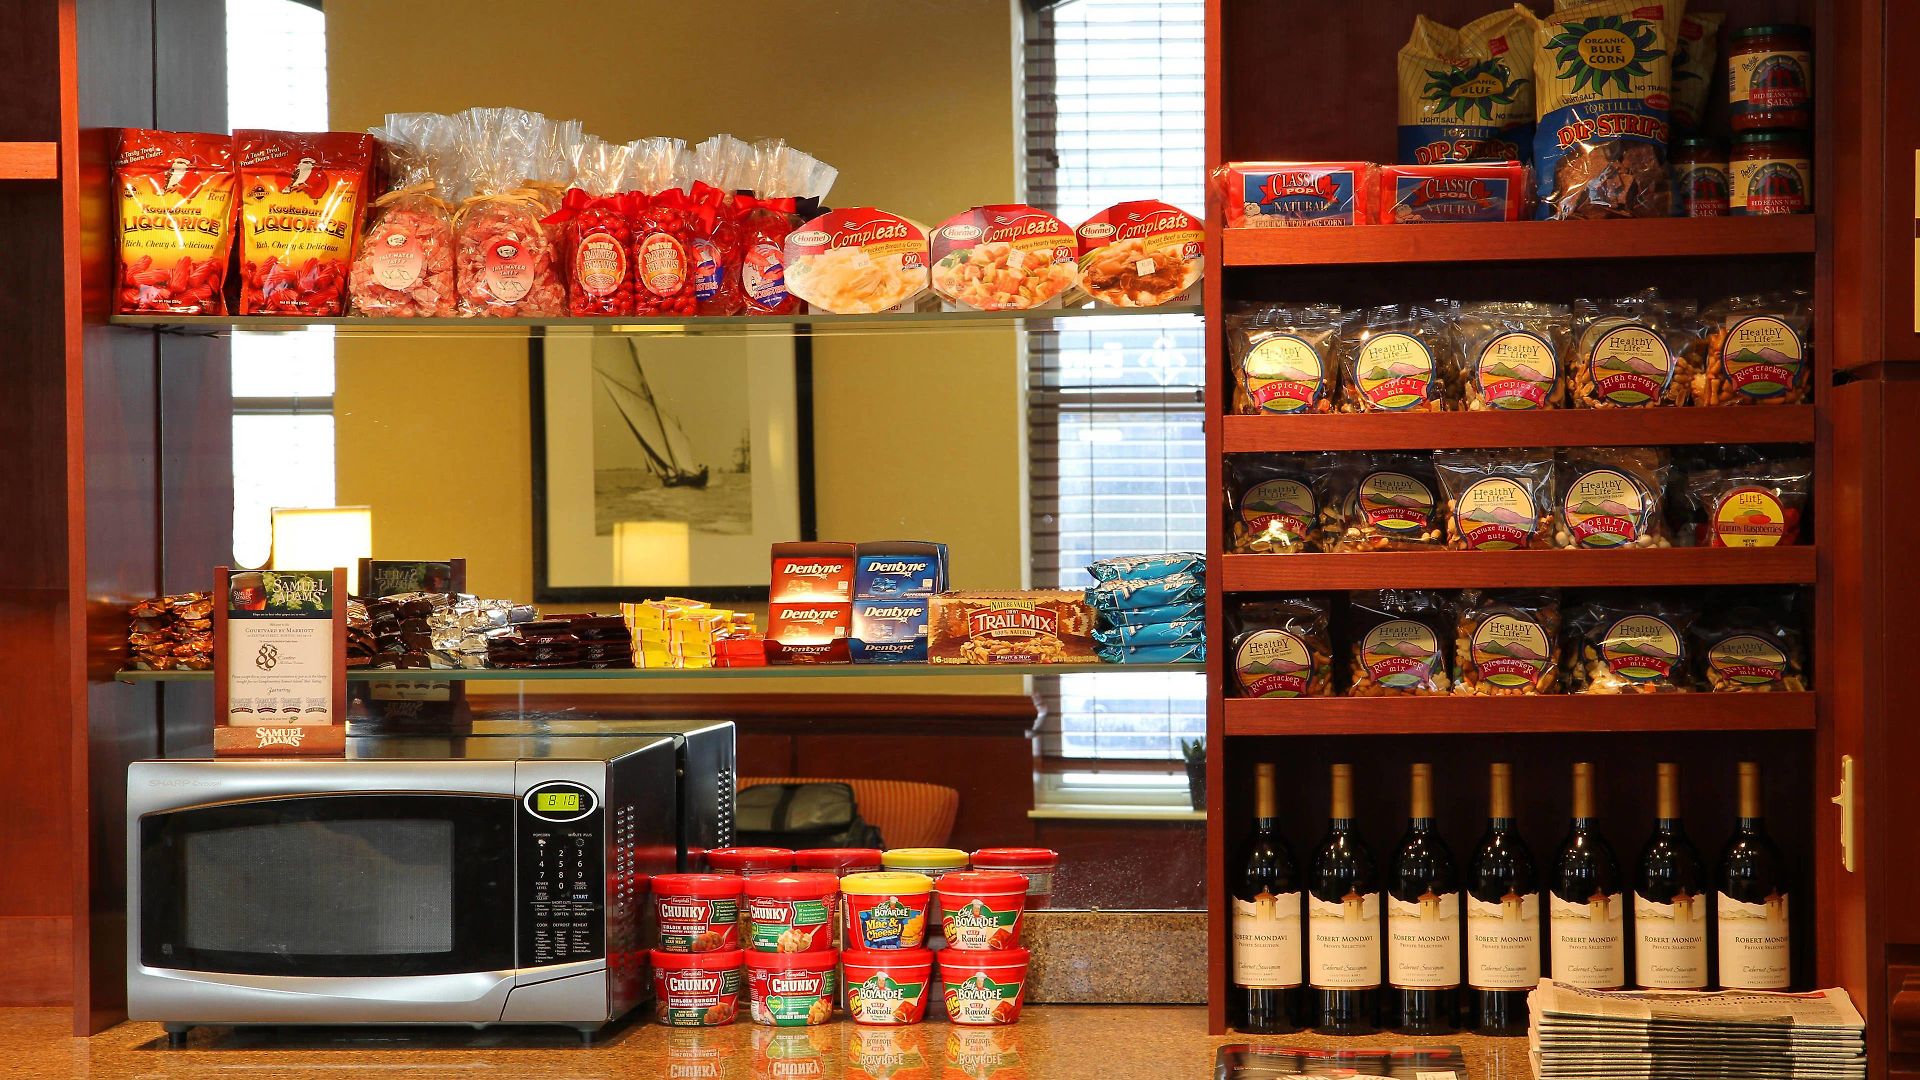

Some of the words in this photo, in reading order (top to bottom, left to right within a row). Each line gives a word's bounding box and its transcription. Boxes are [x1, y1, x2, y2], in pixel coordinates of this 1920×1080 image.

[1591, 46, 1621, 54] BLUE
[1589, 55, 1625, 64] CORN
[1562, 97, 1577, 105] LIGHT
[1585, 101, 1642, 113] TORTILLA
[1557, 120, 1595, 150] DIP
[1597, 113, 1668, 144] STRIPS
[1415, 141, 1450, 165] DIP
[1272, 172, 1324, 196] CLASSIC
[1426, 178, 1478, 200] CLASSIC
[207, 193, 225, 202] Red
[1274, 201, 1328, 212] NATURAL
[1427, 204, 1479, 215] NATURAL
[1763, 206, 1791, 216] SALSA
[123, 215, 221, 236] LIQUORICE
[1116, 213, 1188, 242] Compleats
[1292, 219, 1322, 227] POPPING
[948, 229, 977, 237] Hormel
[981, 217, 1059, 245] Compleats
[1084, 226, 1112, 234] Hormel
[798, 234, 826, 242] Hormel
[831, 223, 908, 251] Compleats
[1163, 234, 1176, 242] Beef
[1056, 249, 1068, 258] 90
[1185, 244, 1197, 254] 90
[644, 250, 678, 260] BAKED
[905, 254, 917, 264] 90
[645, 259, 679, 271] BEANS
[1735, 368, 1753, 382] Rice
[1602, 375, 1624, 389] High
[1594, 488, 1612, 496] Life
[1469, 526, 1496, 540] Deluxe
[1590, 525, 1618, 533] raisins
[1744, 524, 1783, 534] Raspberries
[784, 563, 842, 577] Dentyne
[868, 561, 926, 575] Dentyne
[273, 578, 328, 593] SAMUEL
[276, 590, 323, 606] ADAMS
[991, 601, 1012, 611] NATURE
[1013, 601, 1034, 611] VALLEY
[780, 609, 838, 622] Dentyne
[864, 607, 923, 620] Dentyne
[975, 613, 1020, 632] TRAIL
[1022, 614, 1052, 631] MIX
[1503, 630, 1520, 638] Life
[782, 646, 831, 654] Dentyne
[865, 644, 914, 653] Dentyne
[1263, 647, 1279, 655] Life
[1250, 678, 1267, 693] Rice
[1266, 683, 1282, 691] mix
[256, 727, 305, 740] SAMUEL
[258, 736, 302, 749] ADAMS
[539, 849, 545, 857] 1
[558, 849, 564, 857] 2
[577, 849, 583, 857] 3
[539, 860, 545, 868] 4
[558, 860, 564, 868] 5
[577, 860, 583, 868] 6
[539, 871, 545, 879] 7
[558, 871, 564, 879] 8
[577, 871, 583, 879] 9
[558, 882, 564, 890] 0
[662, 904, 706, 921] CHUNKY
[751, 905, 788, 922] CHUNKY
[875, 908, 909, 918] BOYARDEE
[958, 907, 973, 917] Chef
[866, 920, 888, 931] Mac
[889, 917, 898, 927] &
[955, 916, 999, 928] BOYARDEE
[866, 925, 901, 940] Cheese!
[1393, 933, 1415, 942] ROBERT
[962, 934, 987, 943] Ravioli
[1500, 935, 1532, 943] MONDAVI
[670, 977, 718, 993] CHUNKY
[772, 978, 820, 993] CHUNKY
[860, 988, 904, 1001] BOYARDEE
[958, 988, 1002, 1001] BOYARDEE
[866, 1006, 892, 1015] Ravioli
[965, 1006, 990, 1015] Ravioli
